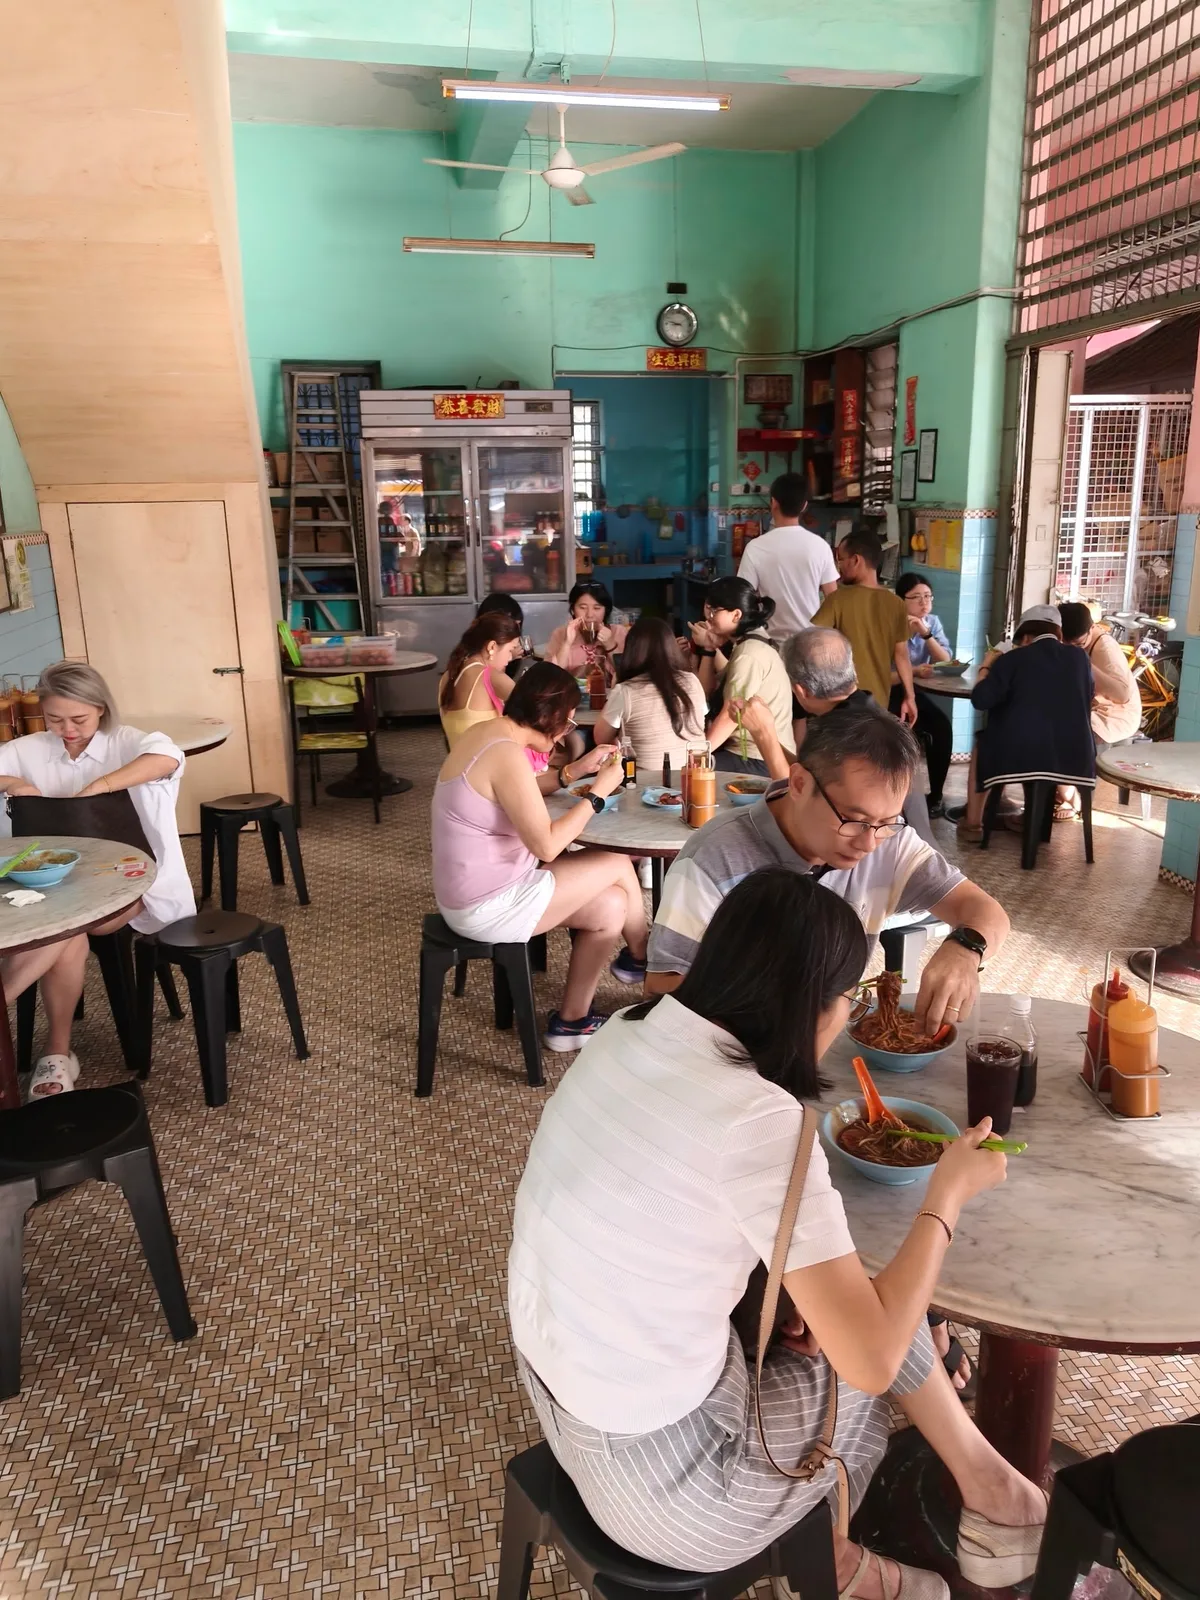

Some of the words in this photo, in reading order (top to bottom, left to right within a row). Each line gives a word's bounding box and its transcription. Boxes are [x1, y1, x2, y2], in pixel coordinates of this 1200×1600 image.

[651, 352, 702, 368] 生意興隆
[441, 399, 500, 415] 恭喜發財
